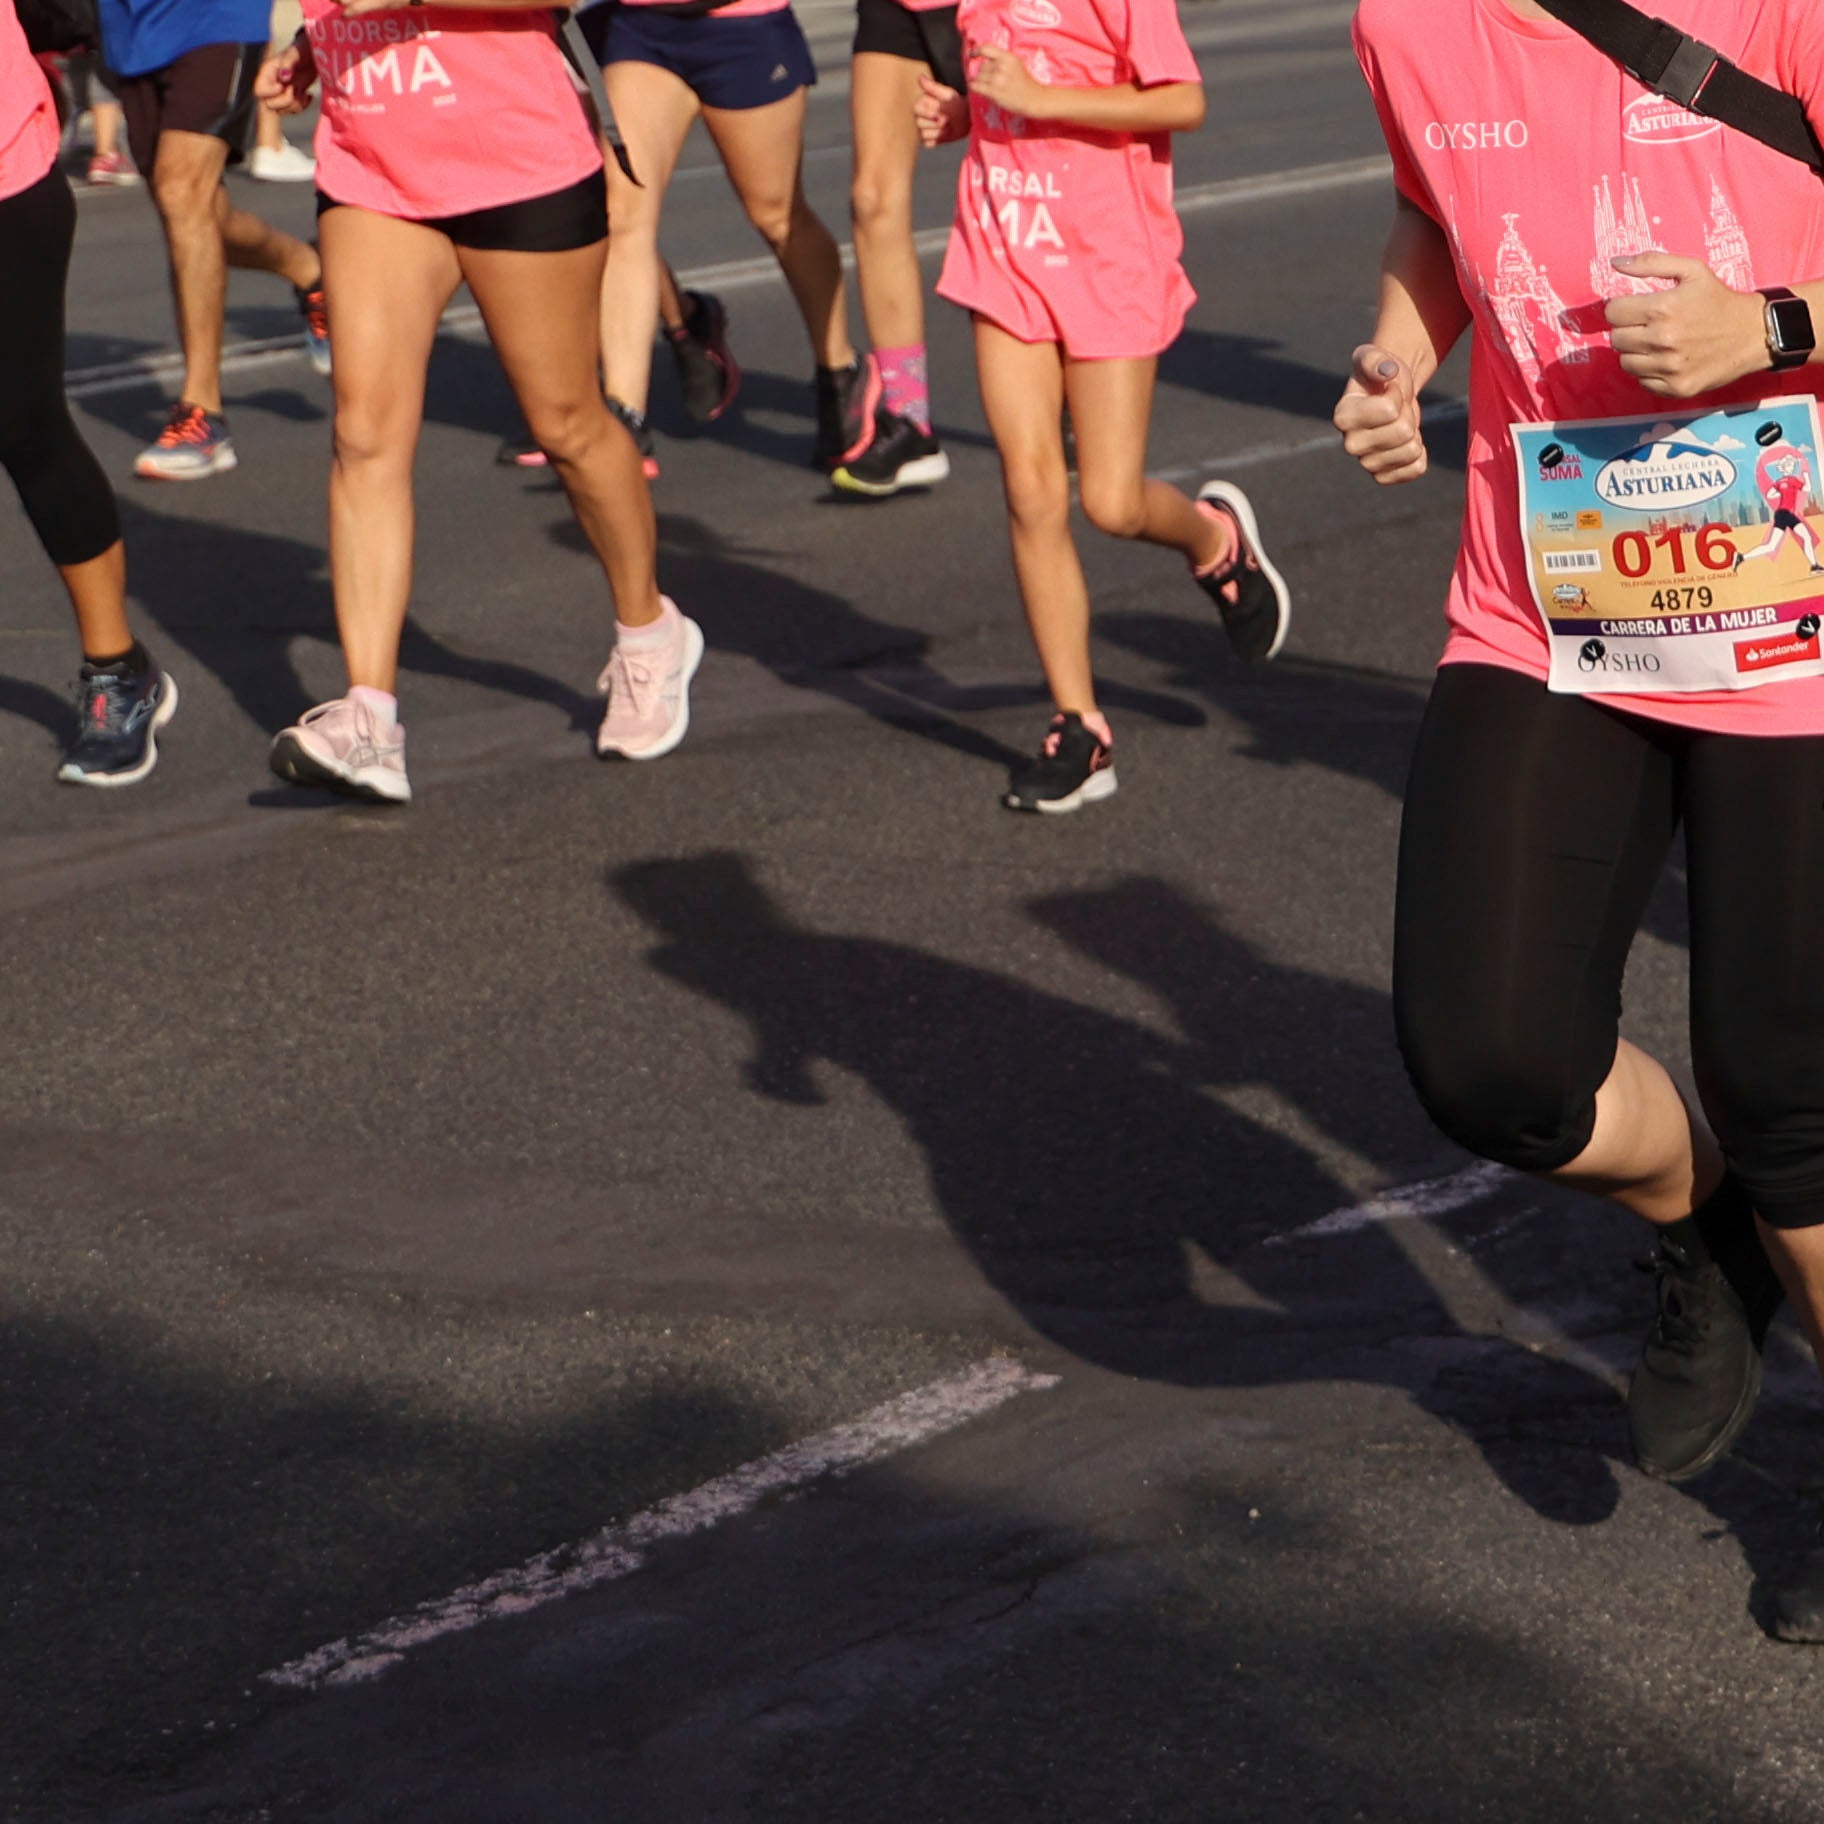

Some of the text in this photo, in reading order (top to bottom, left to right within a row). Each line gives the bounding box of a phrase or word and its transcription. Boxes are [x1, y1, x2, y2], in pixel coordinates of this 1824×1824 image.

[1425, 119, 1528, 150] OYSHO
[1605, 468, 1727, 498] ASTURIANA
[1612, 522, 1738, 578] 016
[1650, 585, 1713, 611] 4879
[1600, 607, 1777, 636] CARRERA DE LA MUJER
[1578, 652, 1661, 673] OYSHO
[1759, 640, 1809, 659] Santander
